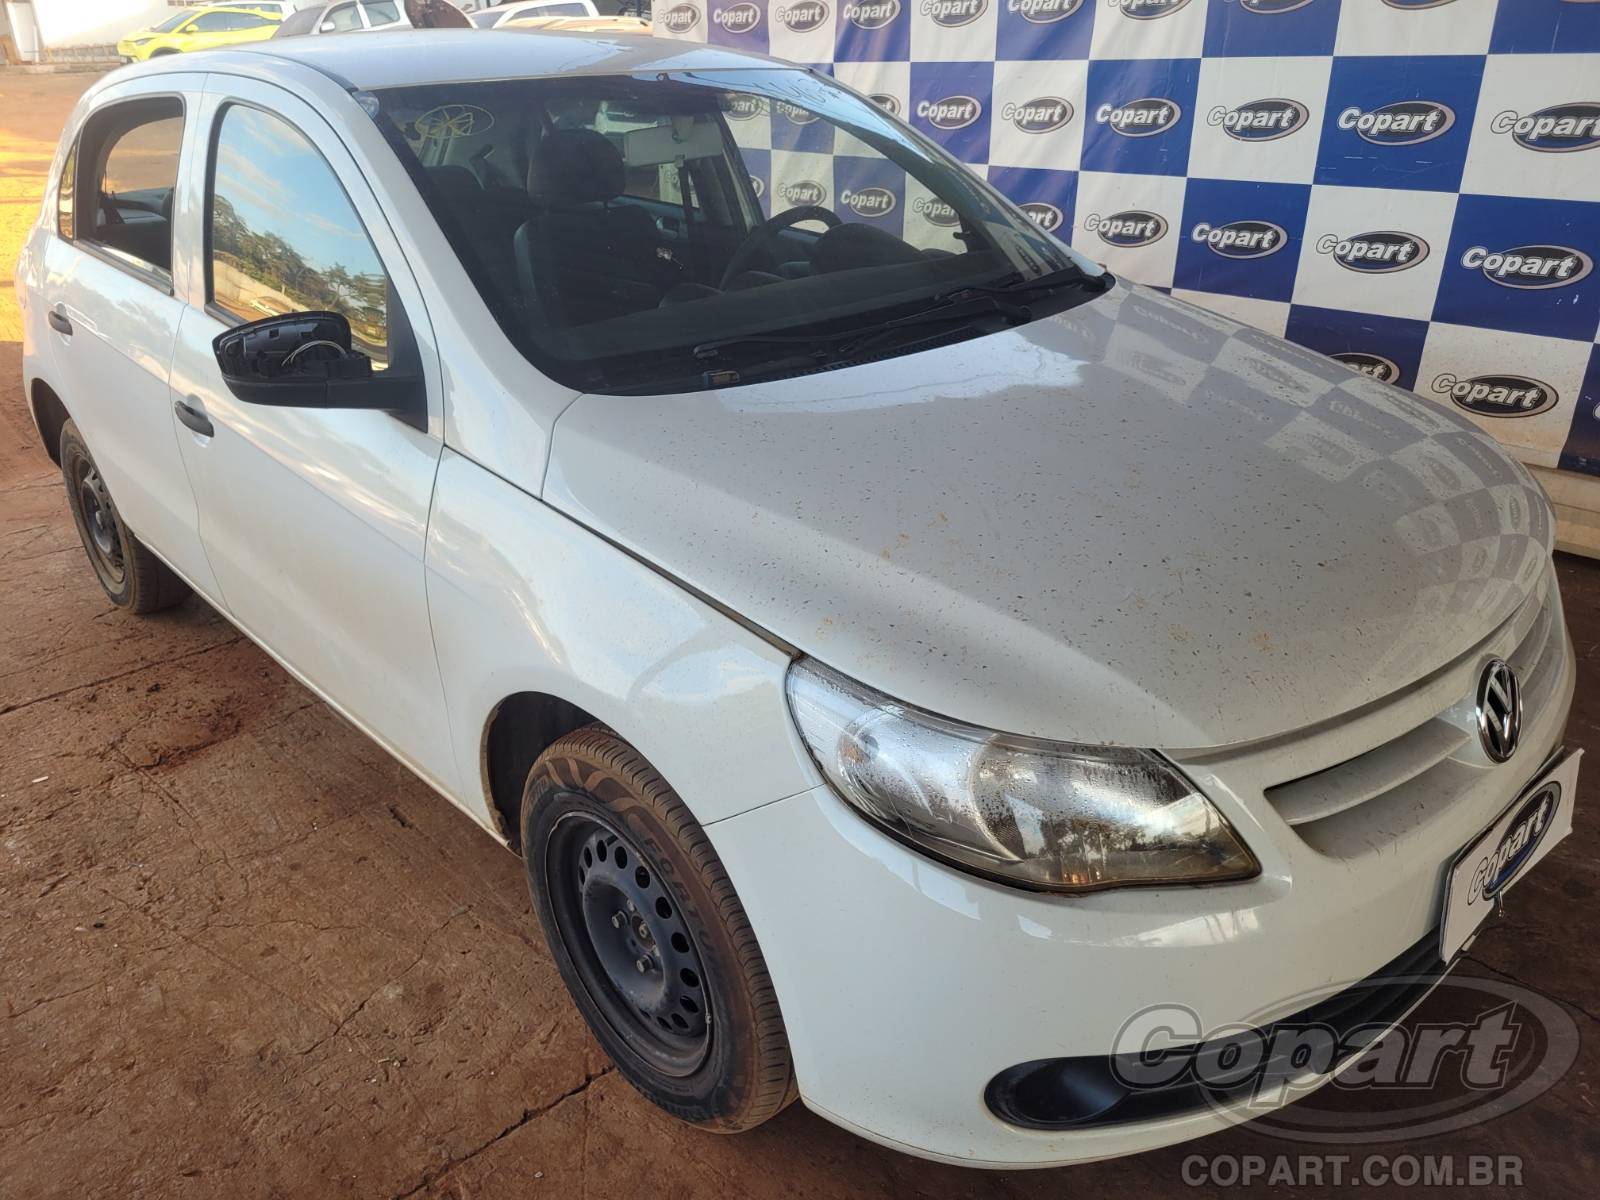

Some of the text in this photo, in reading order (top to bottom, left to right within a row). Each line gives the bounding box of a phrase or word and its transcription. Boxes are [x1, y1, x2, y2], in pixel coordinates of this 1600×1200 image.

[713, 8, 755, 26] Copart
[775, 5, 822, 25] Copart
[843, 2, 893, 21] Copart
[920, 0, 979, 20] Copart
[916, 100, 973, 122] Copart
[1001, 102, 1064, 124] Copart
[1095, 103, 1171, 126] Copart
[1207, 105, 1296, 132] Copart
[1337, 107, 1440, 136] Copart
[777, 183, 818, 201] Copart
[840, 190, 889, 208] Copart
[1084, 213, 1158, 237] Copart
[1191, 222, 1275, 250] Copart
[1316, 234, 1416, 262] Copart
[1460, 246, 1578, 278] Copart
[1431, 373, 1543, 408] Copart
[1467, 795, 1549, 905] Copart
